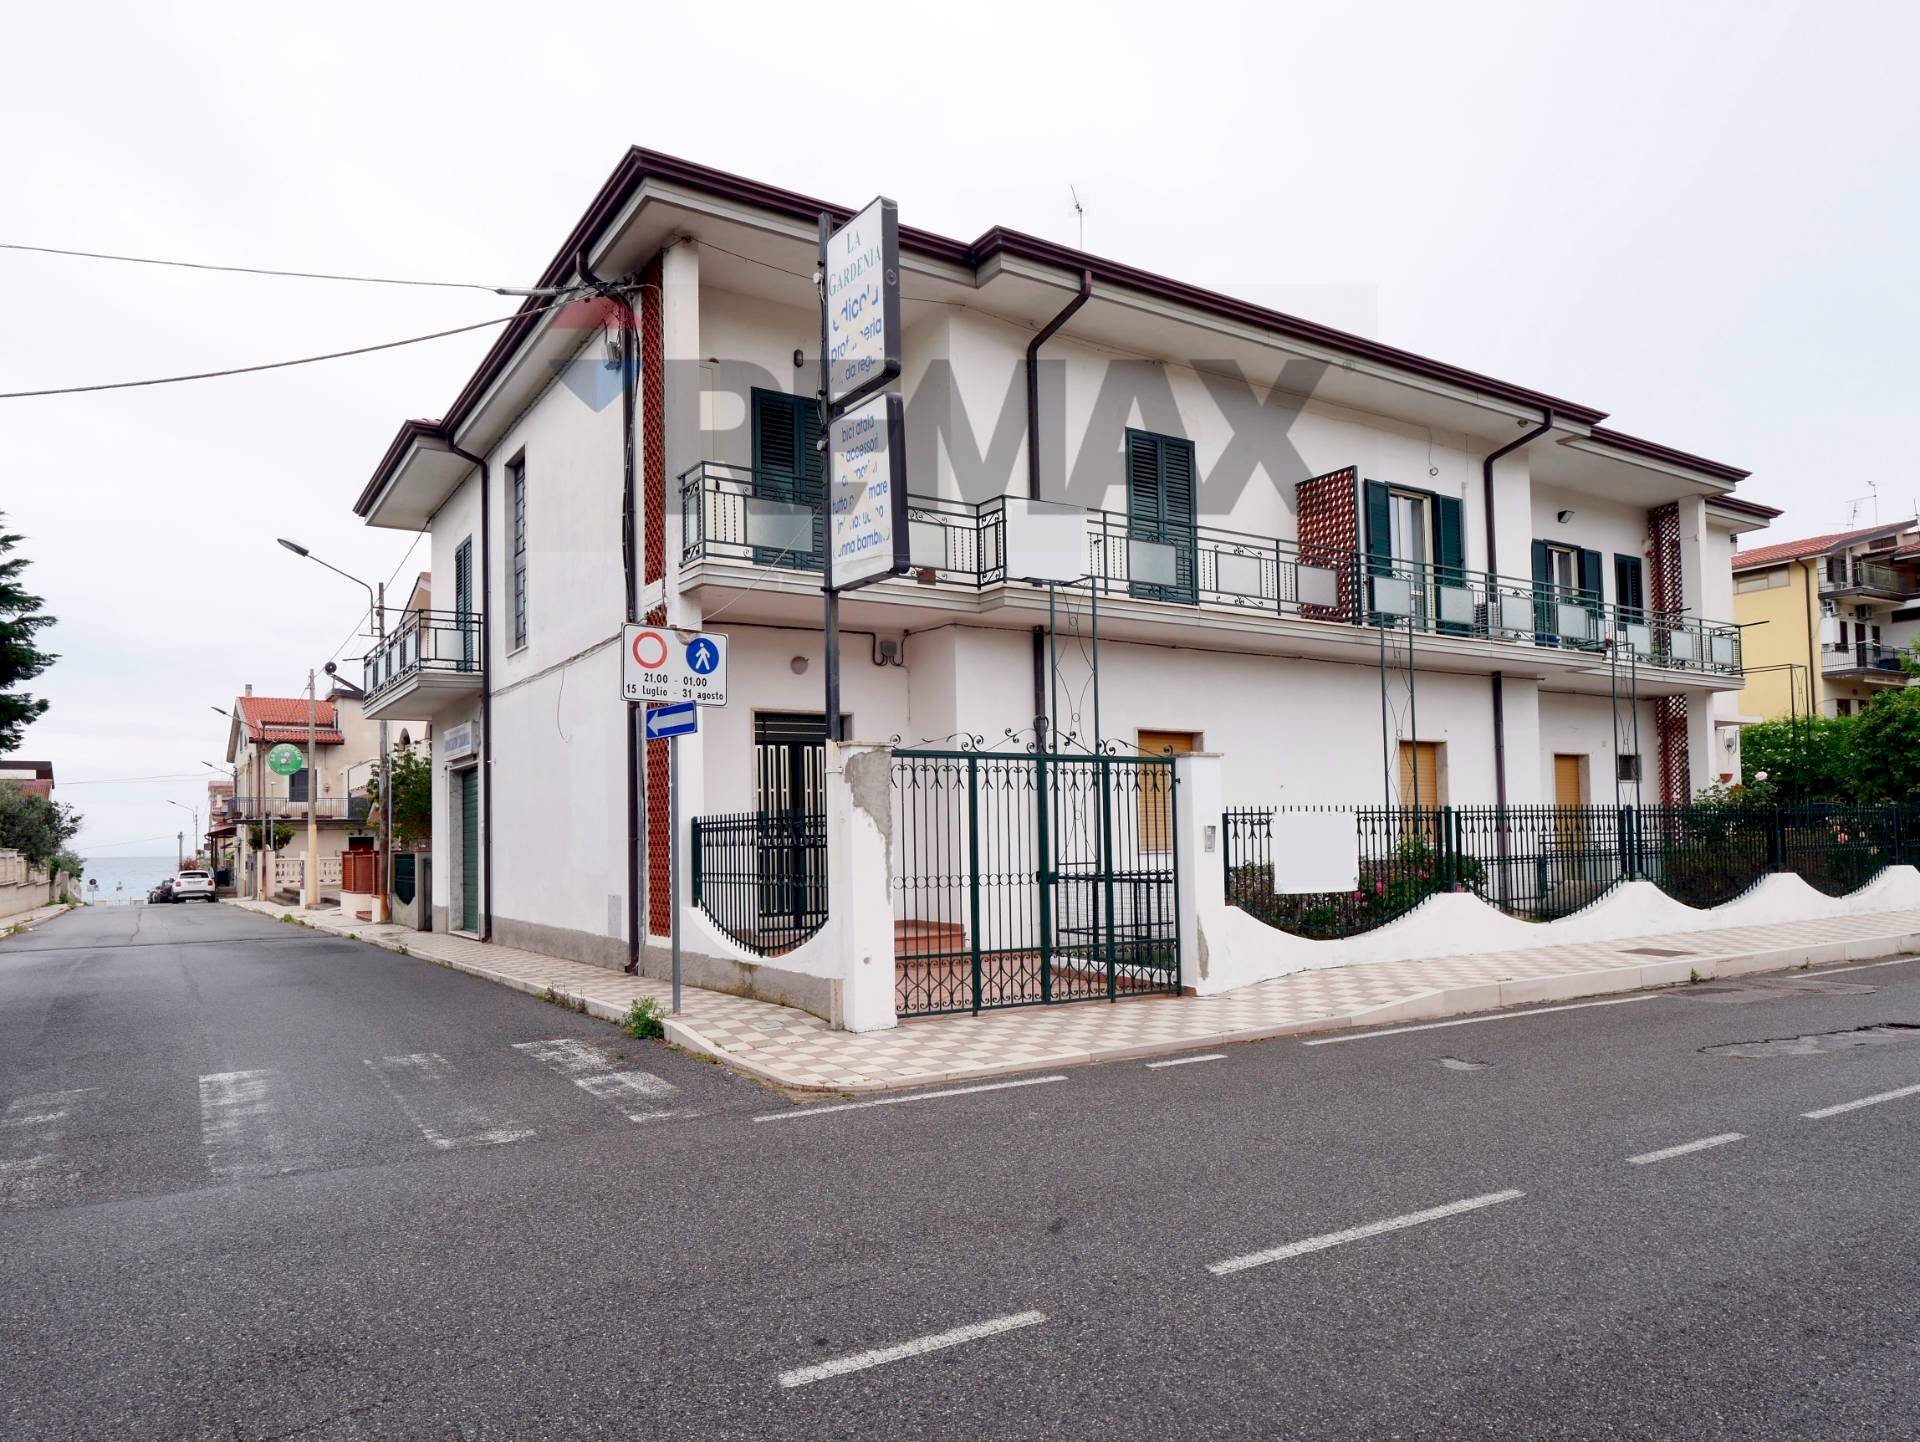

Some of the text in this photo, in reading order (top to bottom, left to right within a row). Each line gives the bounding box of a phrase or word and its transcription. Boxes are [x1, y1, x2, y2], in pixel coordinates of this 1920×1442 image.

[846, 231, 861, 254] LA
[828, 244, 881, 296] GARDENIA
[842, 426, 854, 442] bici
[846, 432, 879, 462] accessori
[868, 480, 888, 500] mare
[644, 672, 668, 684] 21.00
[683, 676, 707, 687] 01.00
[627, 684, 637, 693] 15
[642, 685, 668, 697] luglio
[682, 689, 692, 698] 31
[697, 691, 724, 701] agosto
